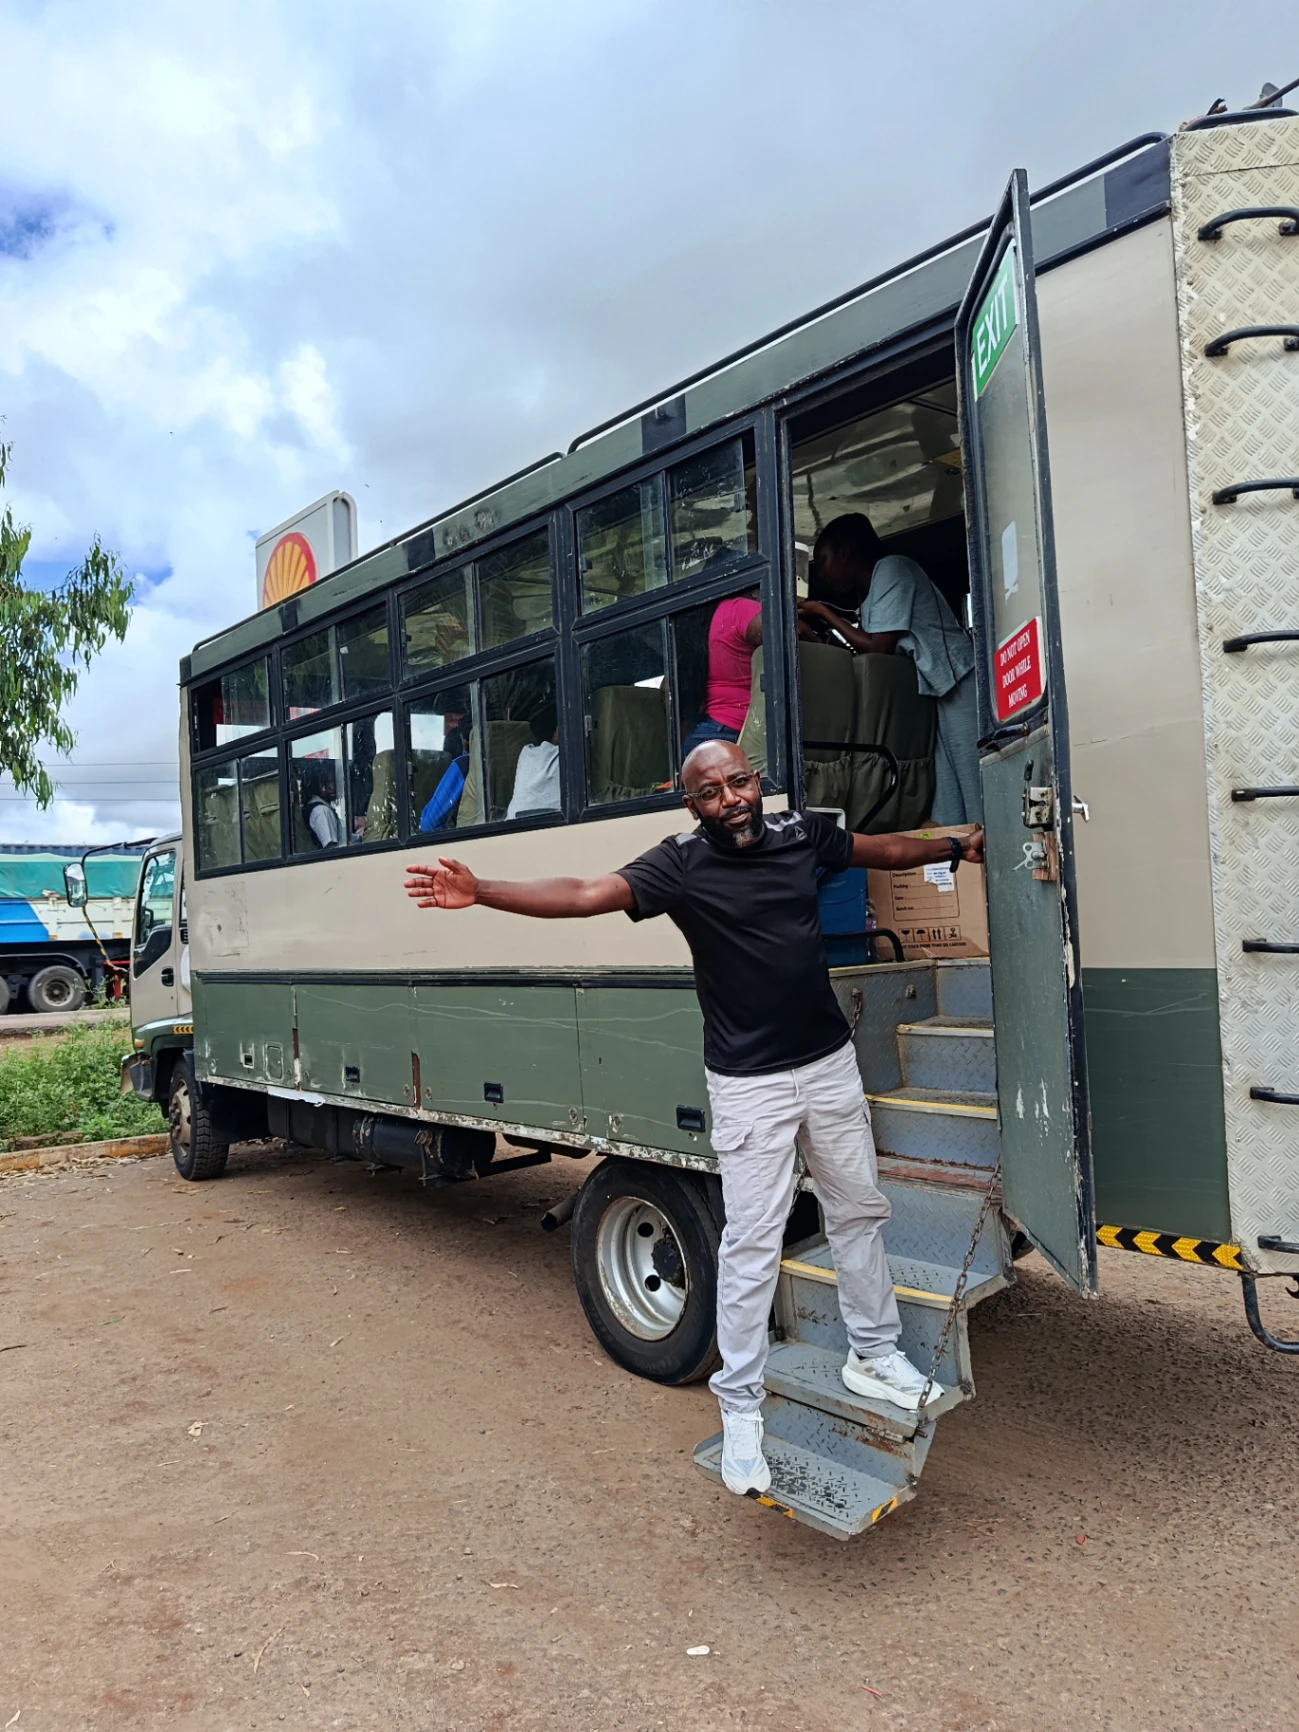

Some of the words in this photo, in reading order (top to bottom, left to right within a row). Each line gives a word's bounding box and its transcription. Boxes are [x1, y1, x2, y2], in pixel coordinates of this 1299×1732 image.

[976, 273, 1007, 378] EXIT
[1000, 650, 1007, 666] DO
[1007, 641, 1017, 661] NOT
[1017, 629, 1031, 652] OPEN
[1002, 668, 1016, 688] DOOR
[1015, 655, 1031, 679] WHILE
[1008, 683, 1028, 708] MOVING
